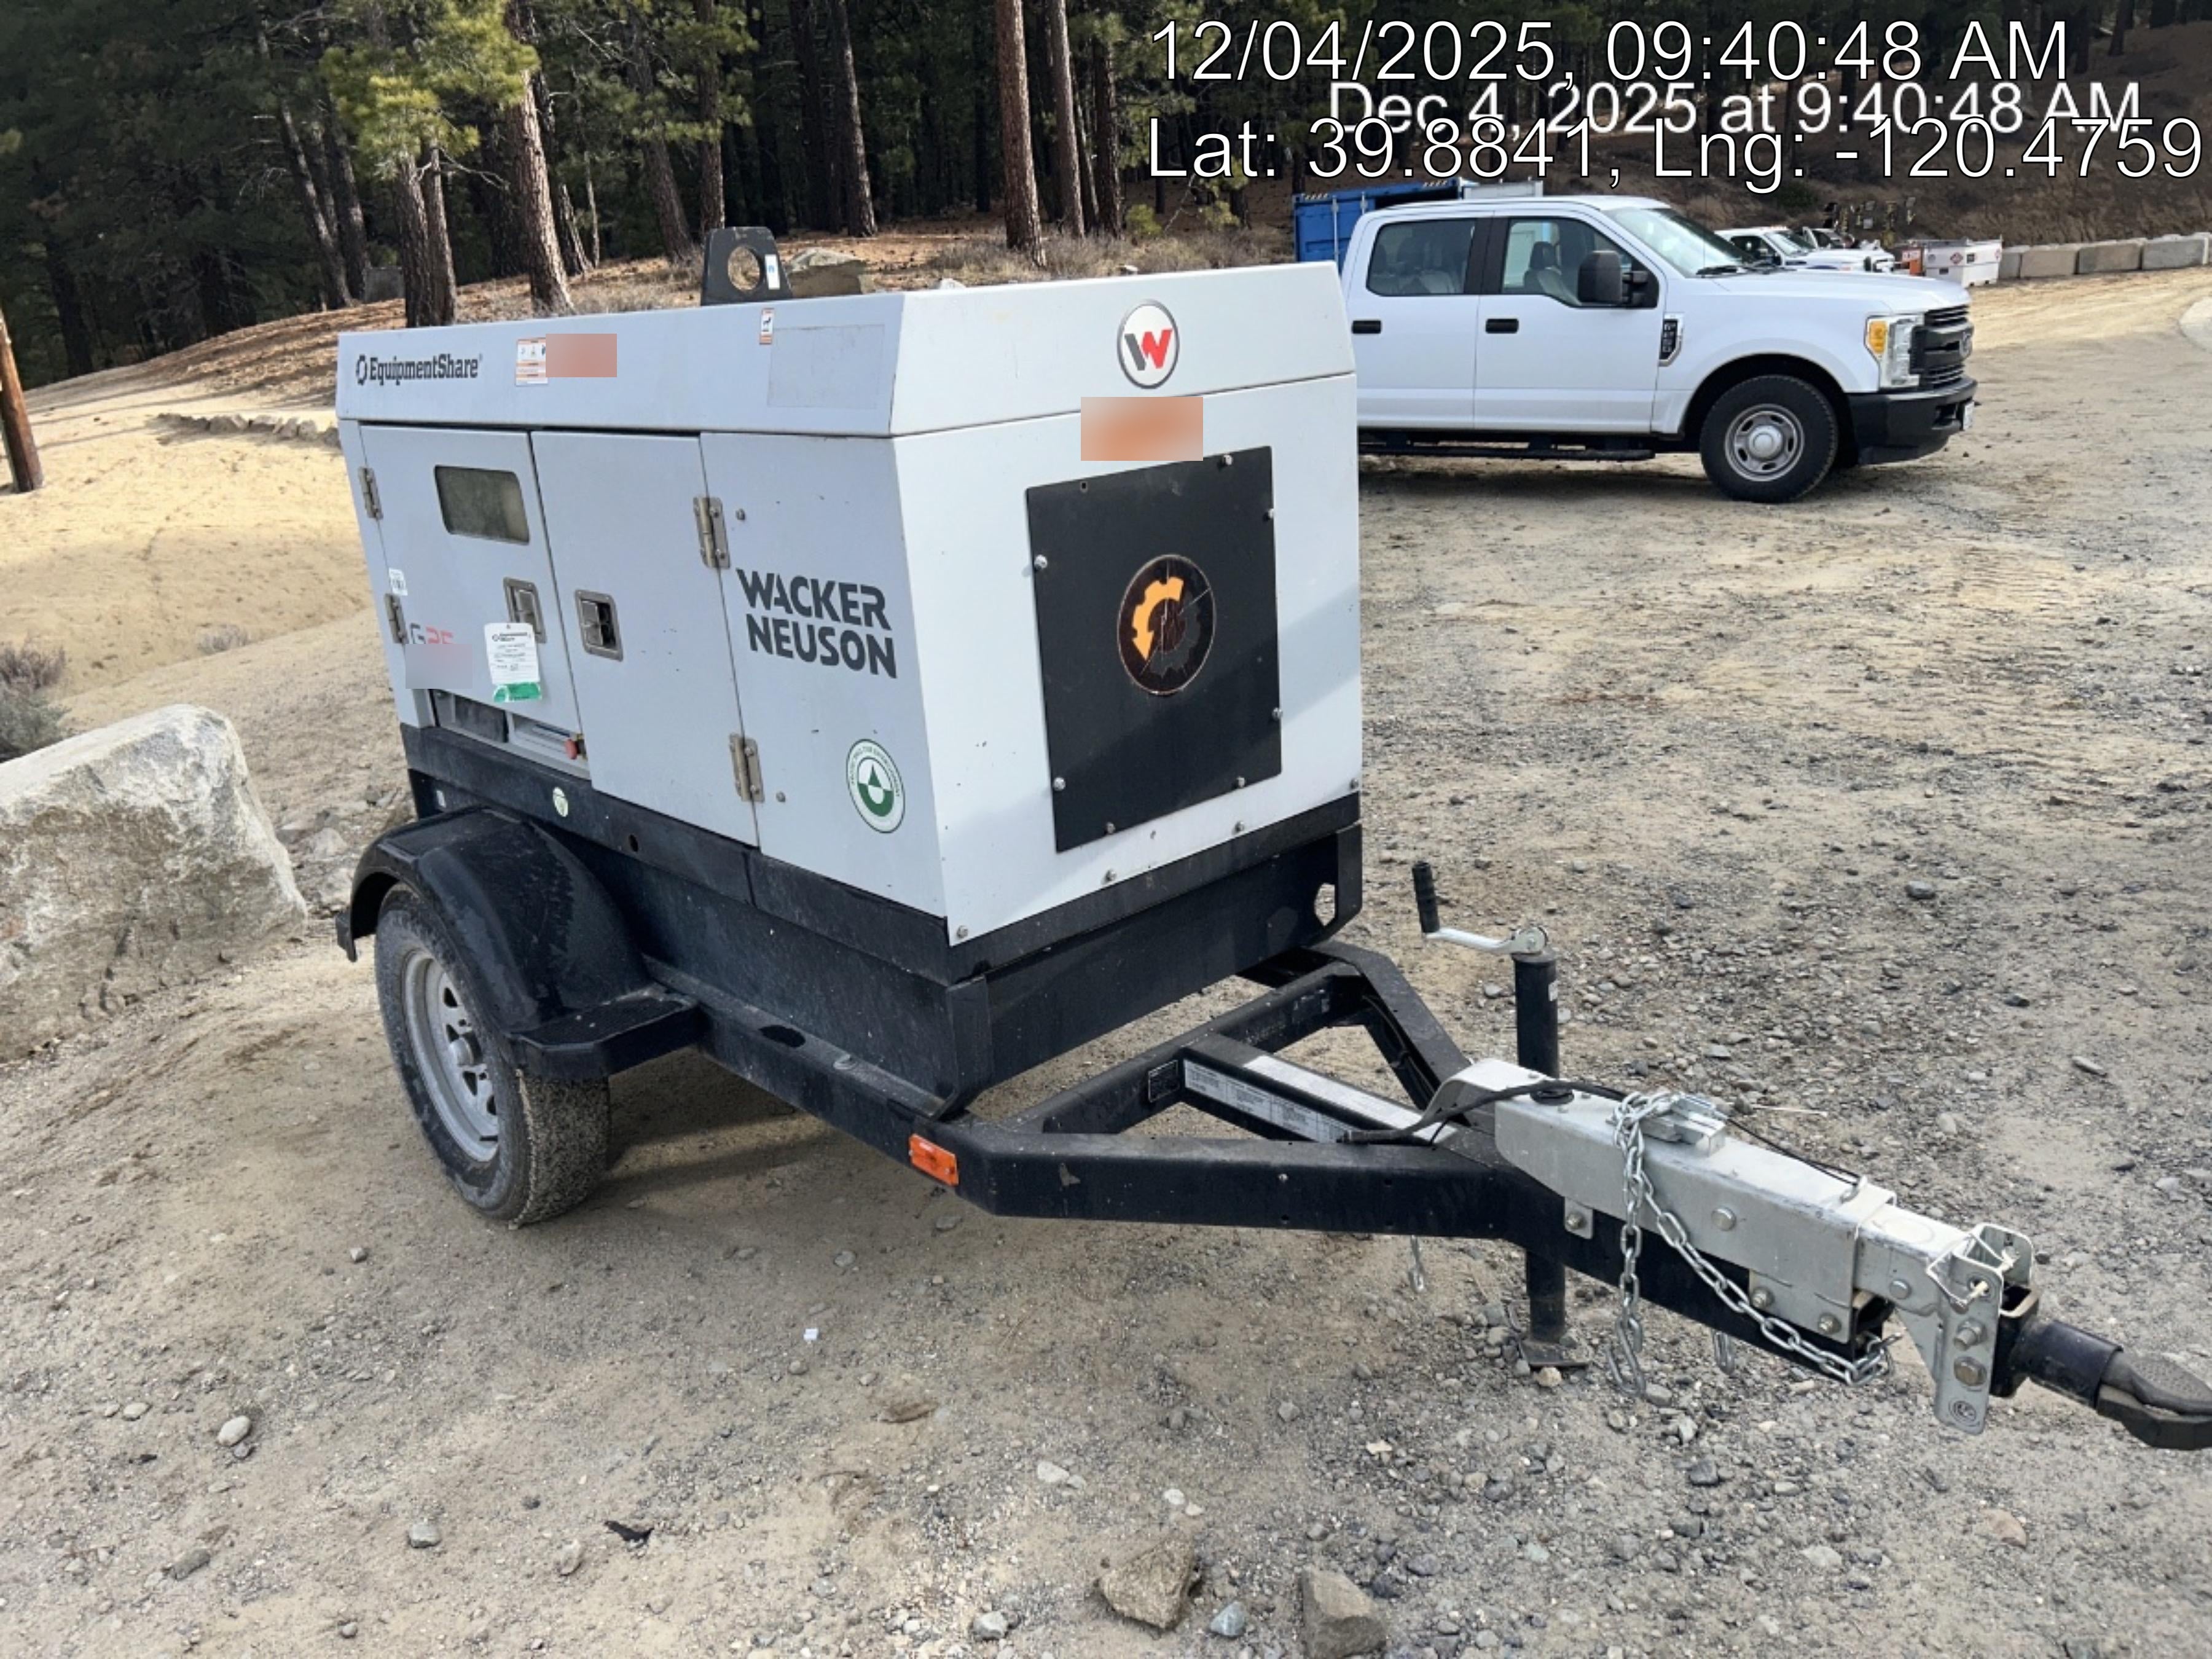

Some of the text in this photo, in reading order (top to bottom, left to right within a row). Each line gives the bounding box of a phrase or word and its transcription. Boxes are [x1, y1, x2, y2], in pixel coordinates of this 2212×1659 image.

[370, 353, 478, 386] EquipmentShare
[1124, 328, 1173, 371] W
[735, 567, 892, 631] WACKER
[746, 613, 897, 679] NEUSON
